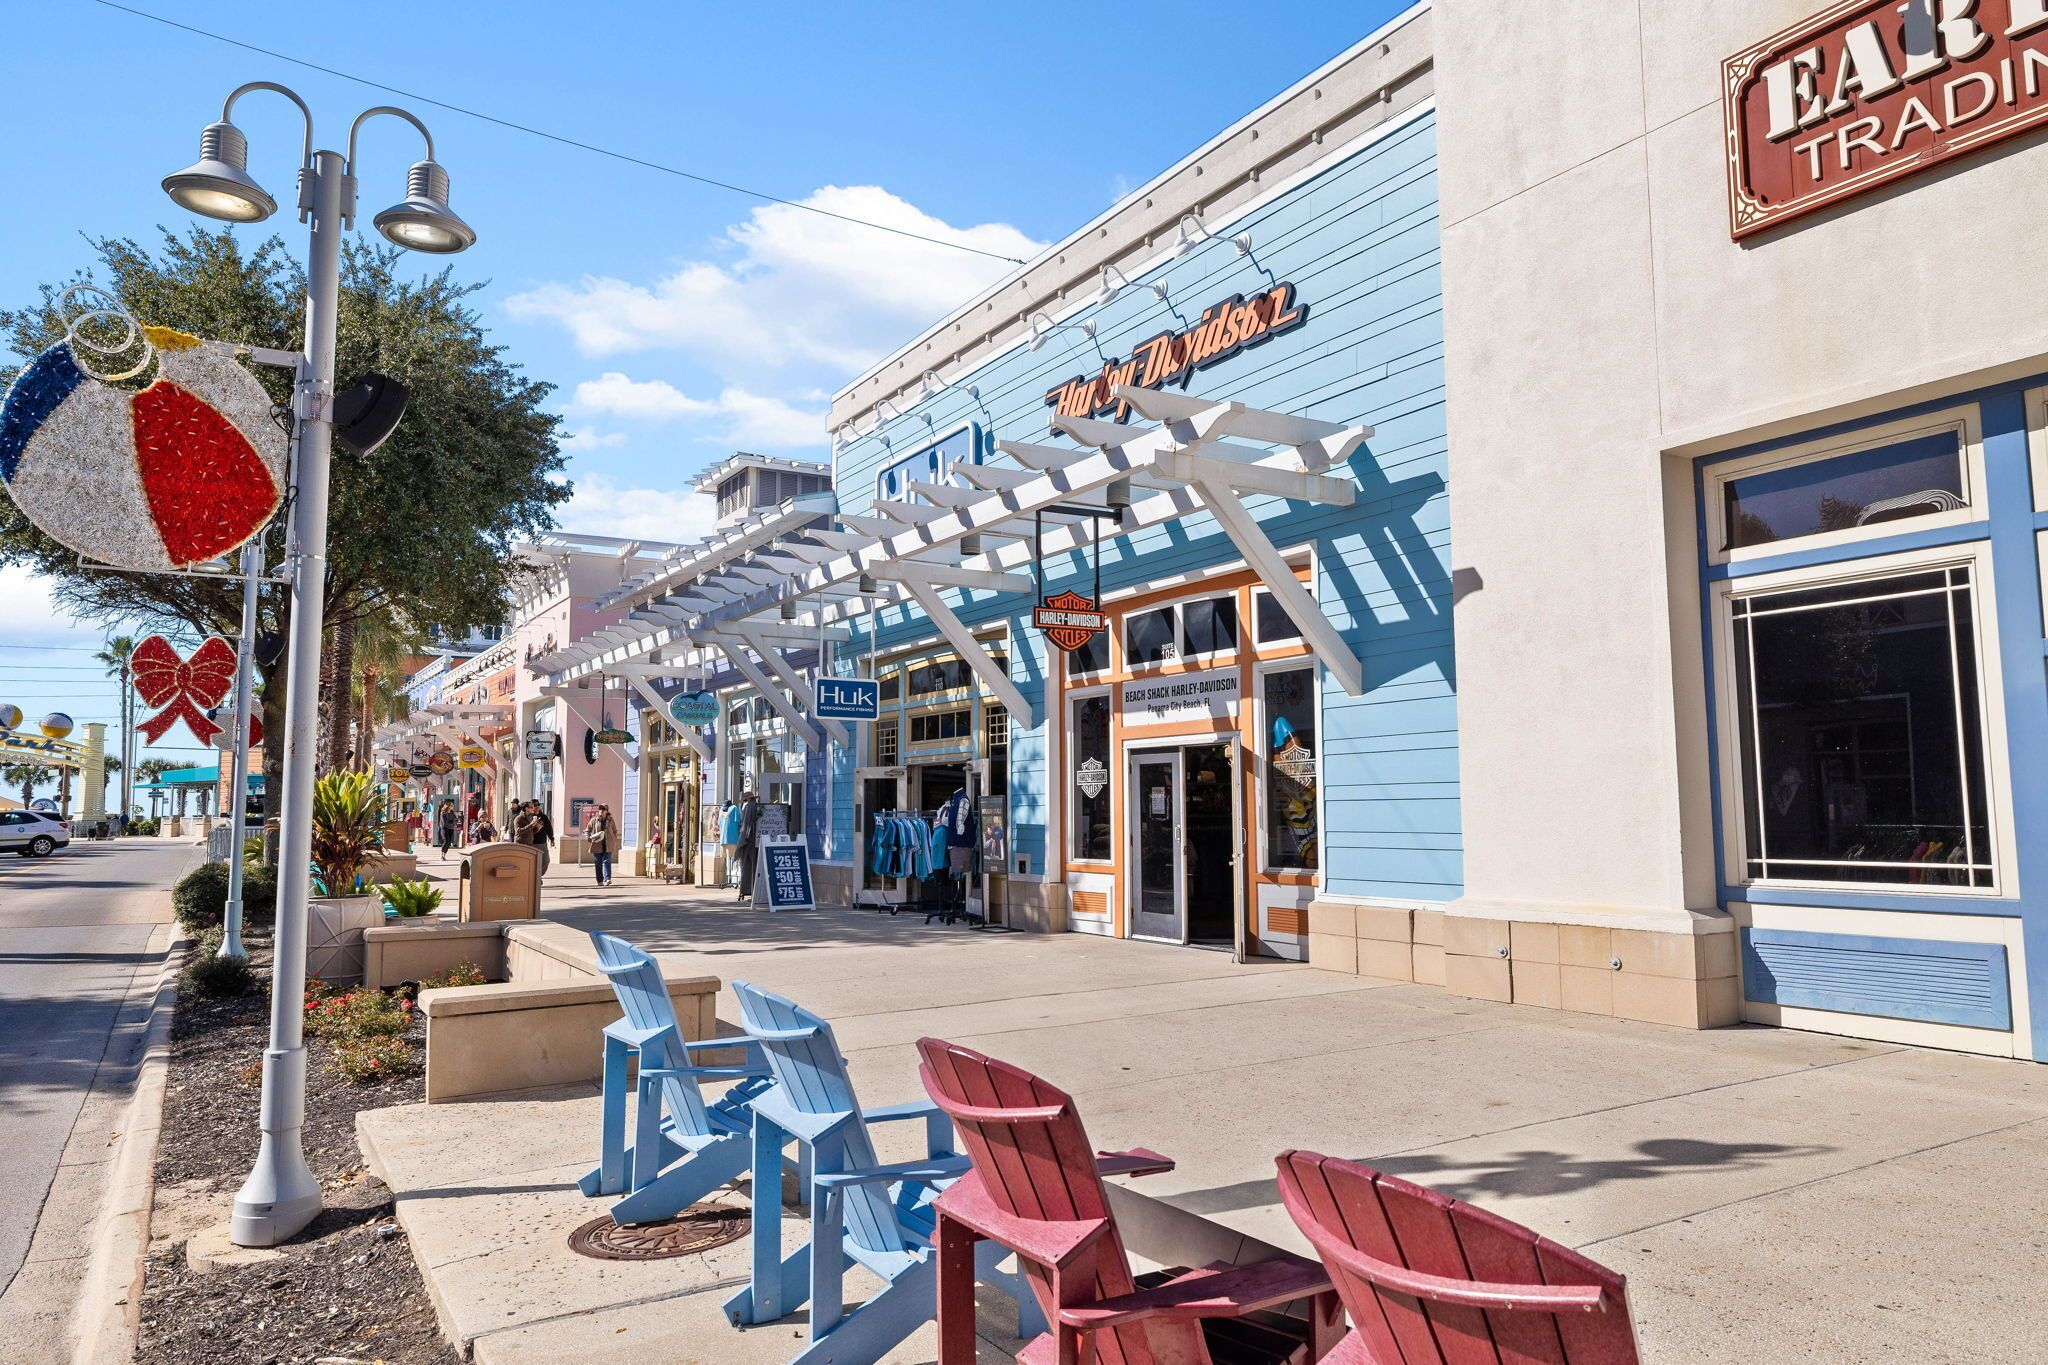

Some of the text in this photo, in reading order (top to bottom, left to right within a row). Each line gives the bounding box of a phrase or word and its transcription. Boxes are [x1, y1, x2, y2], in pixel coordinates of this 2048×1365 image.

[1762, 0, 2048, 141] EAR
[1046, 286, 1297, 418] Harley-Davidson
[1054, 597, 1087, 610] MOTOR
[1040, 611, 1101, 627] HARLEY-DAVIDSON
[1054, 629, 1087, 646] CYCLES
[1161, 649, 1175, 660] 105
[1125, 677, 1237, 703] BEACH SHACK HARLEY-DAVIDSON
[1147, 698, 1211, 713] Panama City Beach, FL
[774, 855, 800, 866] $25 OFF
[776, 871, 802, 883] $50 OFF
[778, 886, 804, 898] $75 OFF
